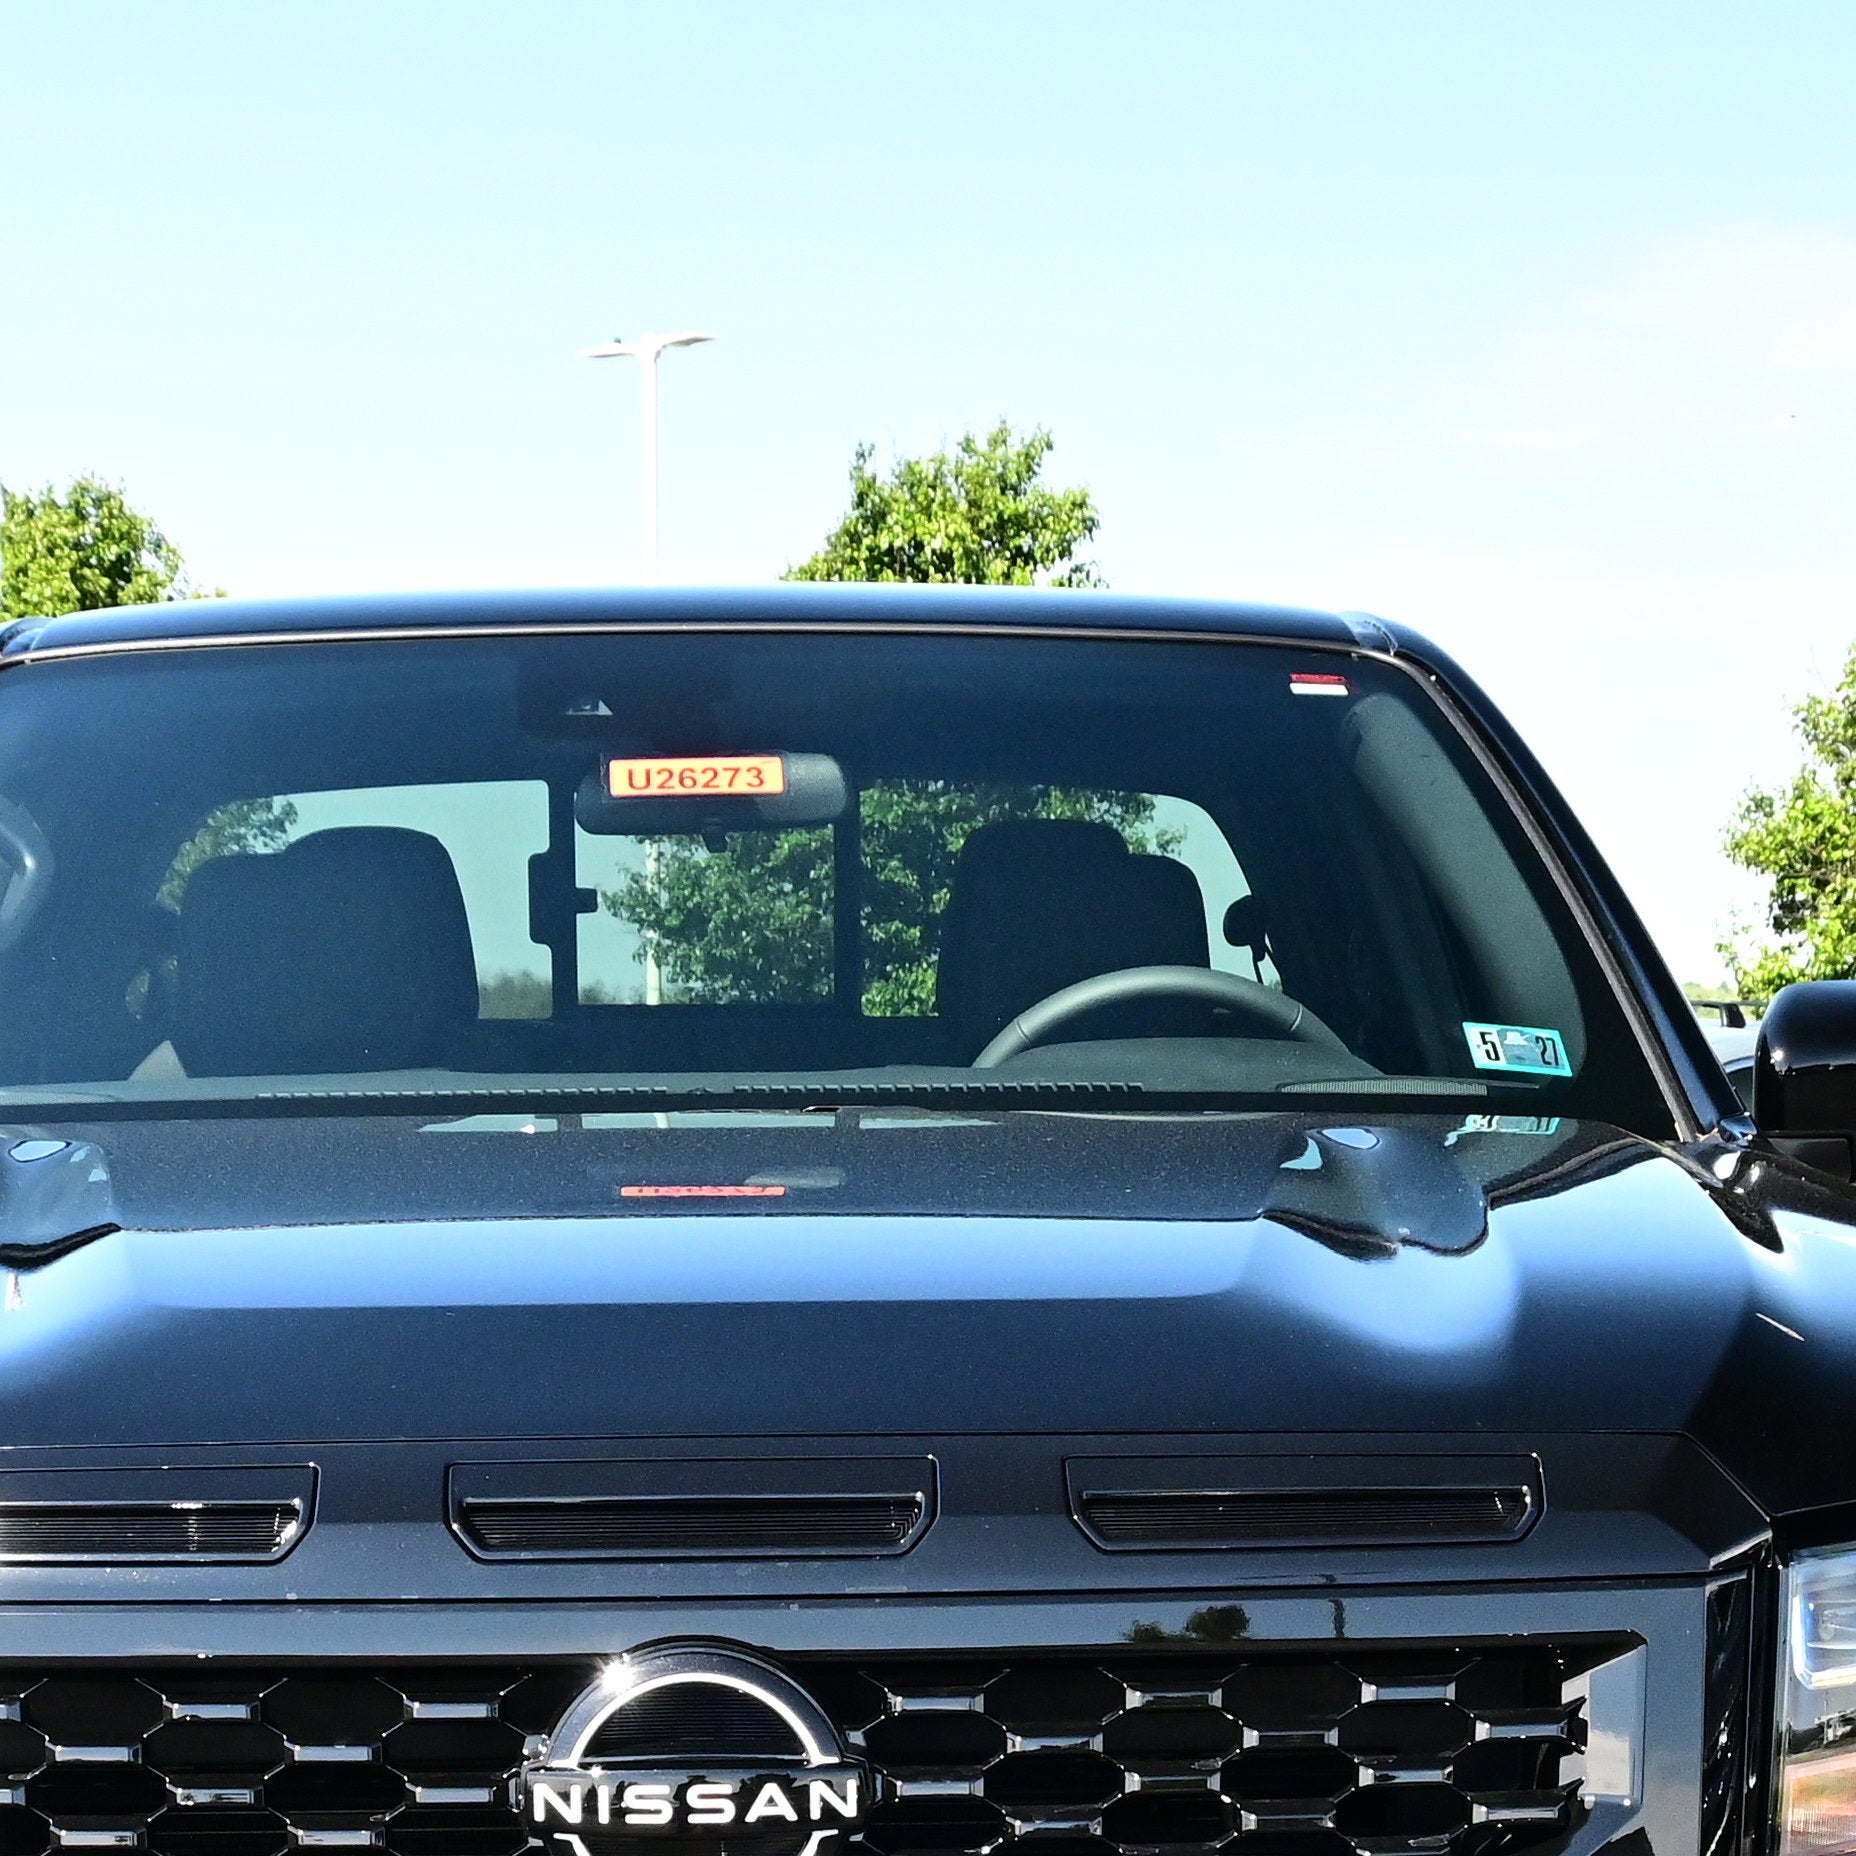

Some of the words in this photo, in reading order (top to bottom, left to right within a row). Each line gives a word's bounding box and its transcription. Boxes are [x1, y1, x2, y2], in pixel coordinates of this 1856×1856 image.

[627, 766, 765, 791] U26273
[1479, 1031, 1501, 1062] 5
[1534, 1035, 1560, 1067] 27
[532, 1778, 858, 1825] NISSAN
